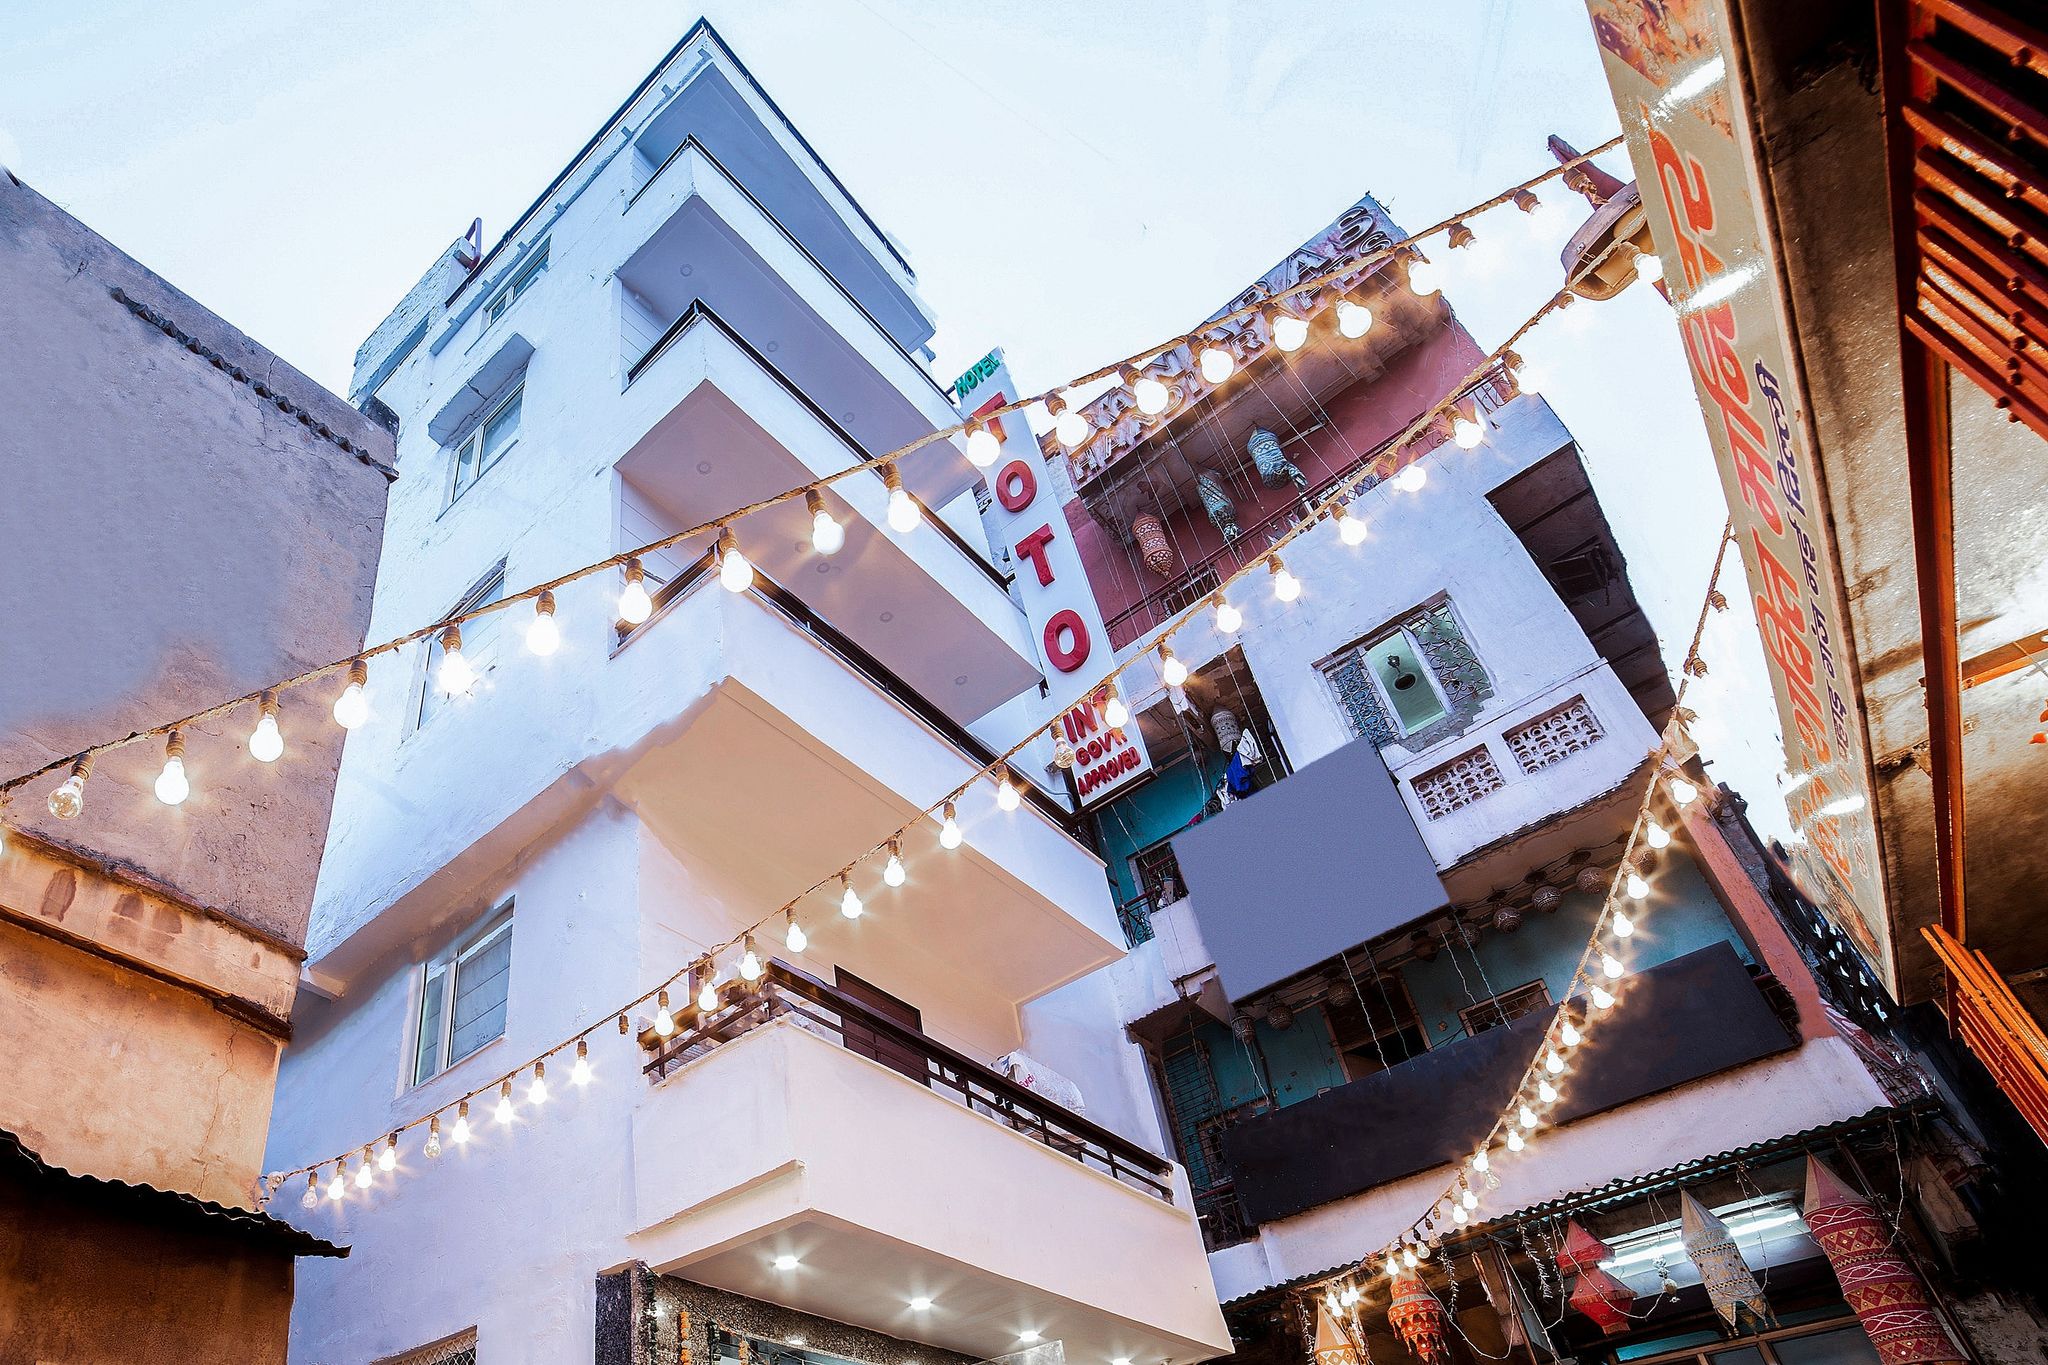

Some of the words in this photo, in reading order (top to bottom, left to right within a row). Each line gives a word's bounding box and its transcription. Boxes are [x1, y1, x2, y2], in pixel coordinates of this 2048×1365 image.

[954, 352, 1000, 399] HOTEL
[1060, 206, 1374, 452] ANARAS
[1072, 231, 1393, 482] HANDIRFTS
[1640, 102, 1784, 536] मन्दिर
[970, 391, 1090, 674] TOTO
[1754, 354, 1807, 520] दिल्ली
[1750, 524, 1832, 764] शक्ति
[1786, 510, 1820, 596] नई
[1808, 597, 1837, 679] गंज
[1077, 746, 1141, 797] APPROVED
